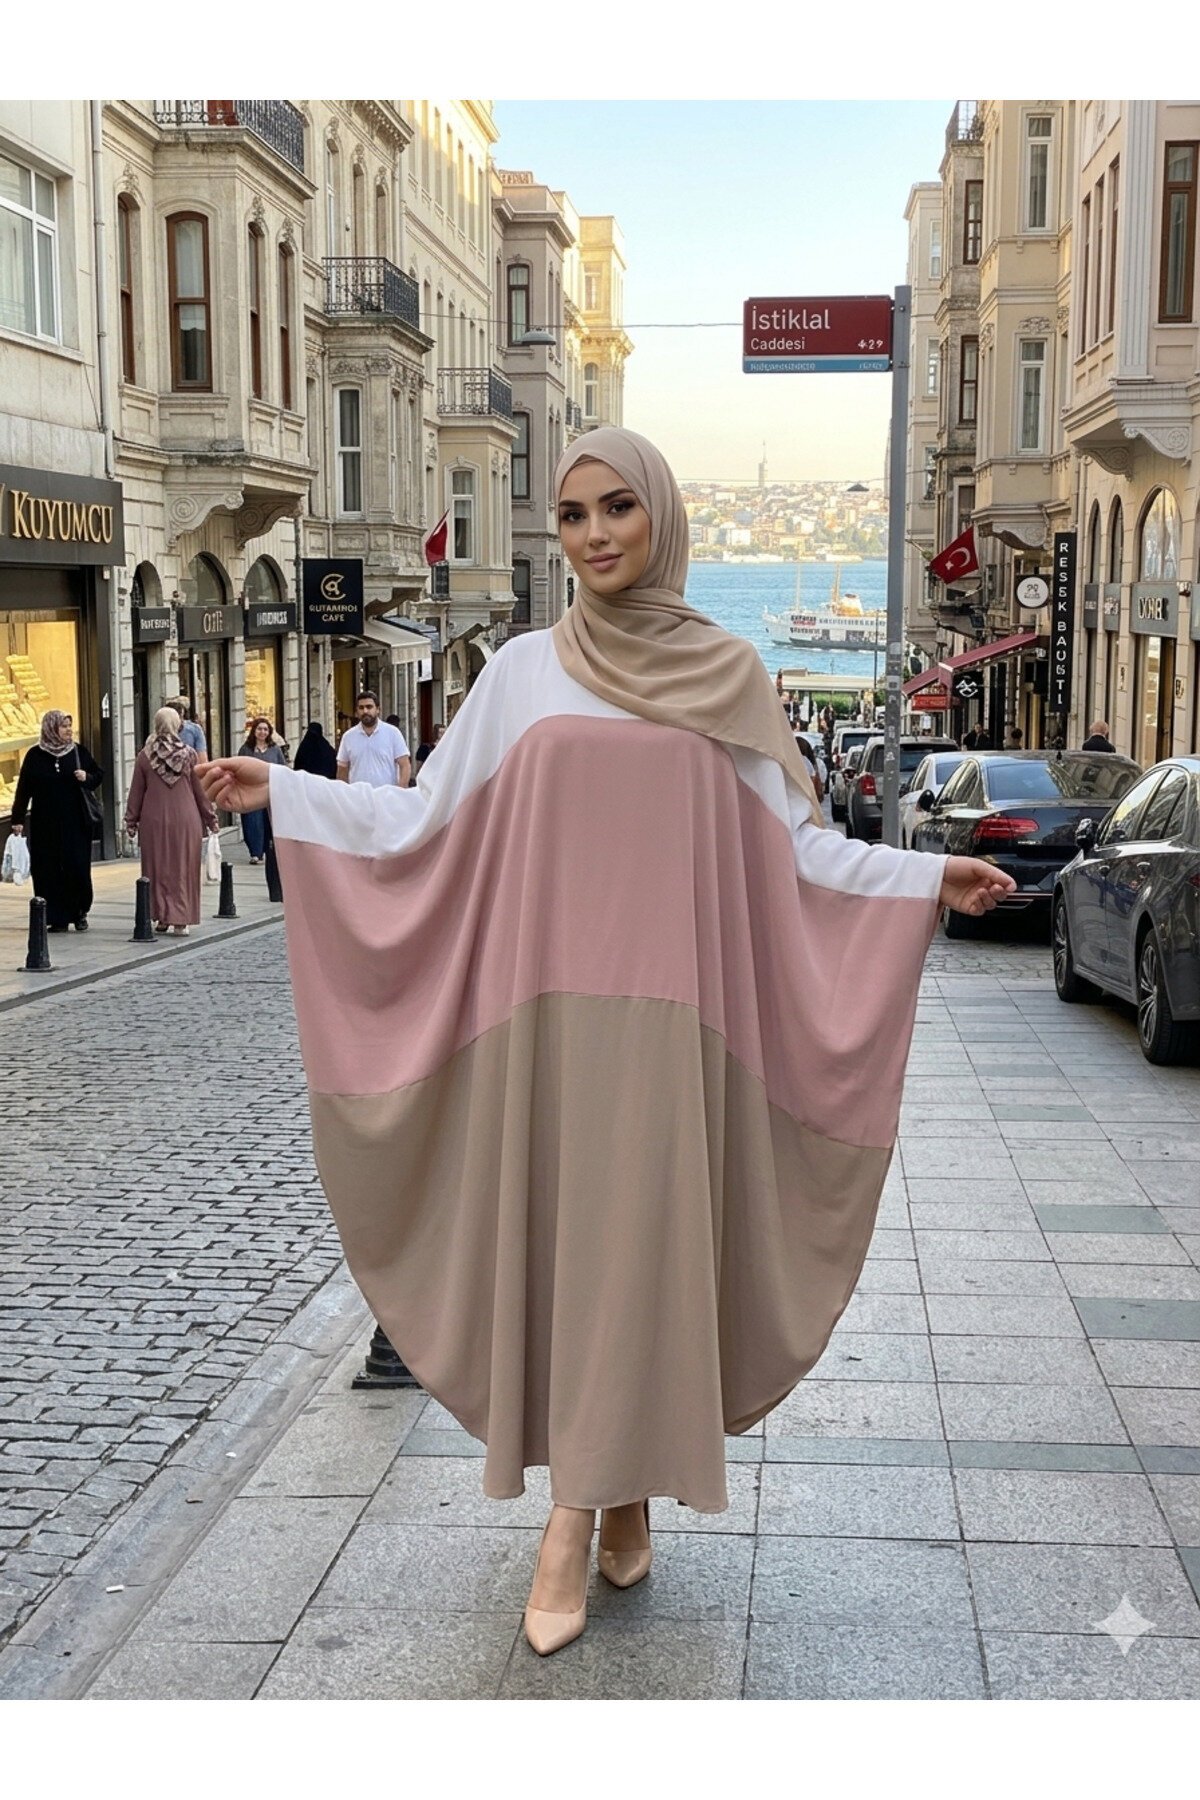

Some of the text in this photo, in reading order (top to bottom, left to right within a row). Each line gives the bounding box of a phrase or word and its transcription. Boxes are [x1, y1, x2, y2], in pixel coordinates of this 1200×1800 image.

[751, 306, 831, 330] İstiklal
[751, 337, 806, 350] Caddesi
[10, 489, 114, 544] KUYUMCU
